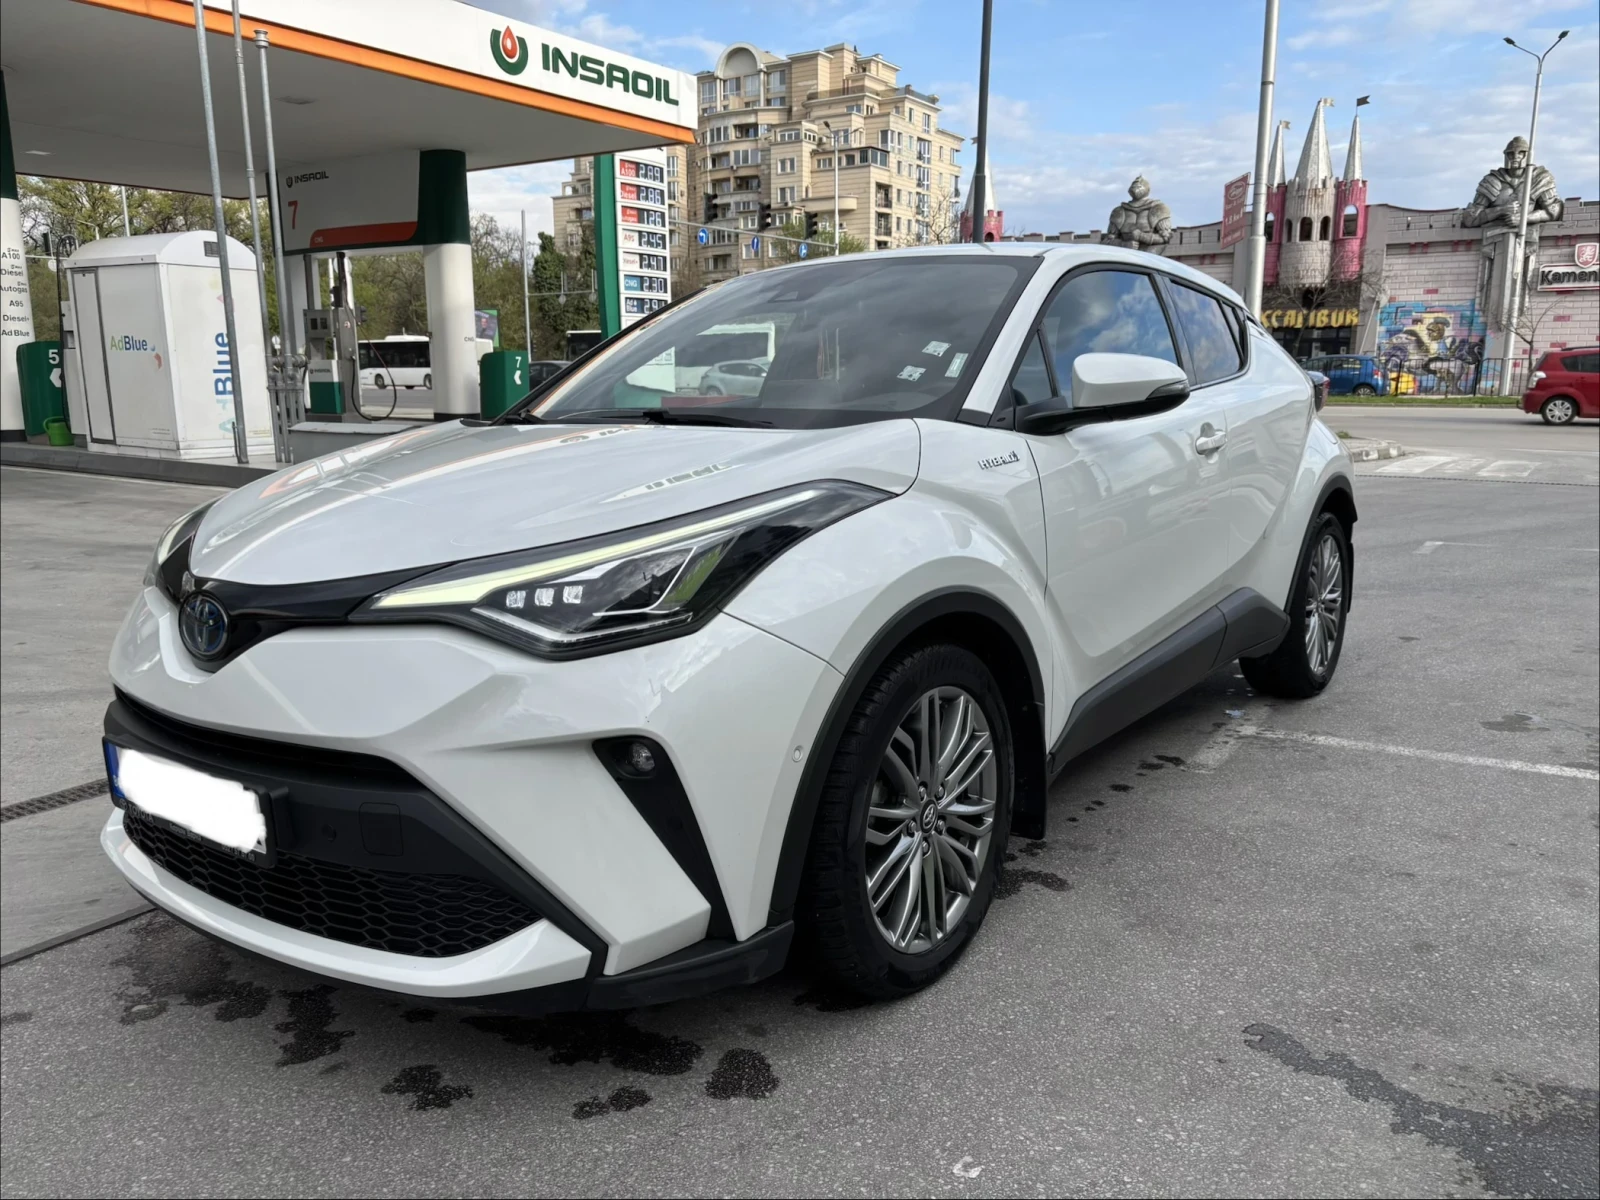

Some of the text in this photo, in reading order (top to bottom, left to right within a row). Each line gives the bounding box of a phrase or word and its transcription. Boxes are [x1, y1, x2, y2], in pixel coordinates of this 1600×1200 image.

[541, 42, 679, 107] INSAOIL
[294, 170, 329, 184] INSAOIL
[639, 164, 661, 183] 2.89
[640, 187, 662, 205] 2.86
[288, 200, 298, 230] 7
[641, 232, 663, 249] 2.45
[2, 251, 21, 260] A100
[642, 254, 663, 271] 2.47
[0, 268, 24, 277] Diesel
[1540, 270, 1598, 286] Kamen
[0, 285, 28, 295] Autogas
[624, 276, 664, 293] CNG 2.30
[9, 299, 24, 308] A95
[14, 330, 30, 338] Blue
[110, 335, 148, 351] AdBlue
[48, 349, 60, 365] 5
[515, 356, 522, 368] 7
